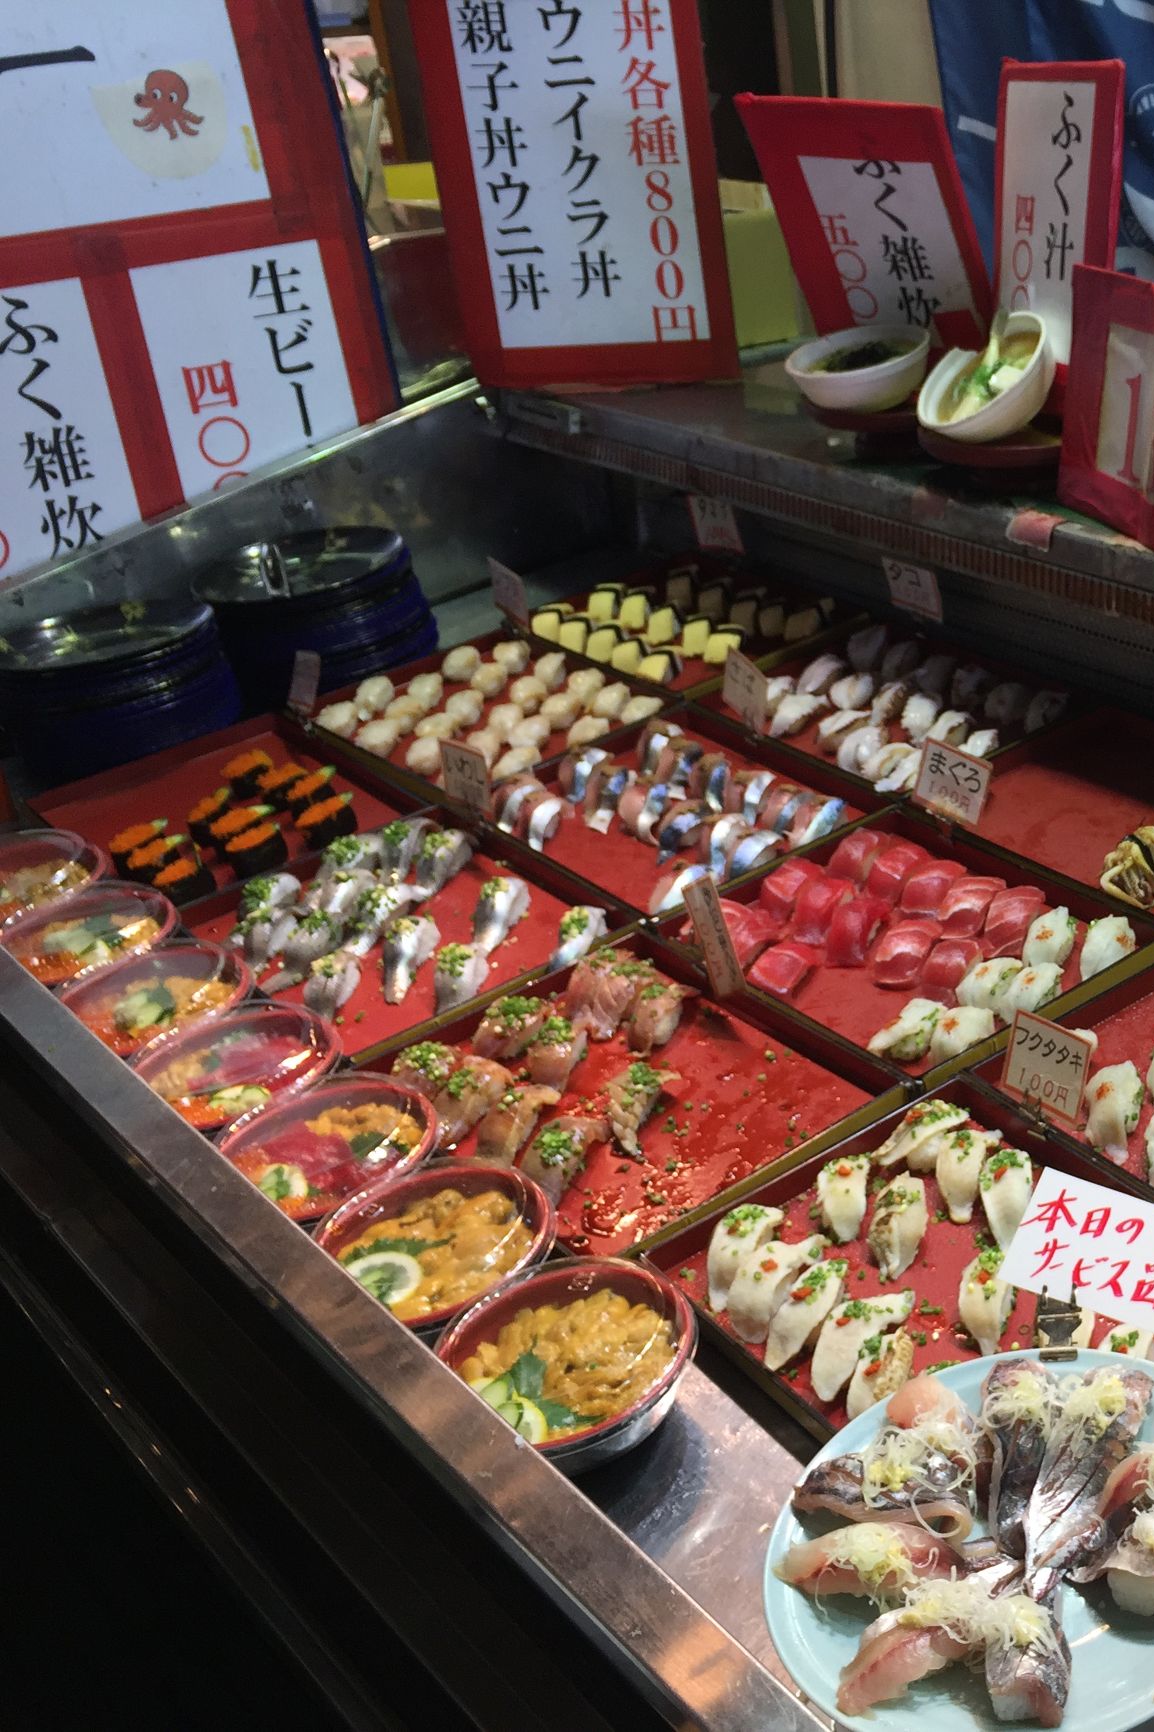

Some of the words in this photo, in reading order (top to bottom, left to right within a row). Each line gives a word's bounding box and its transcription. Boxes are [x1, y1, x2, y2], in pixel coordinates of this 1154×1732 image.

[457, 0, 550, 312] 親子丼ウニ丼
[537, 0, 622, 298] ウニイクラ丼
[1044, 91, 1082, 281] ふく汁
[1018, 1067, 1069, 1109] 100円
[1019, 1188, 1145, 1245] 本日の
